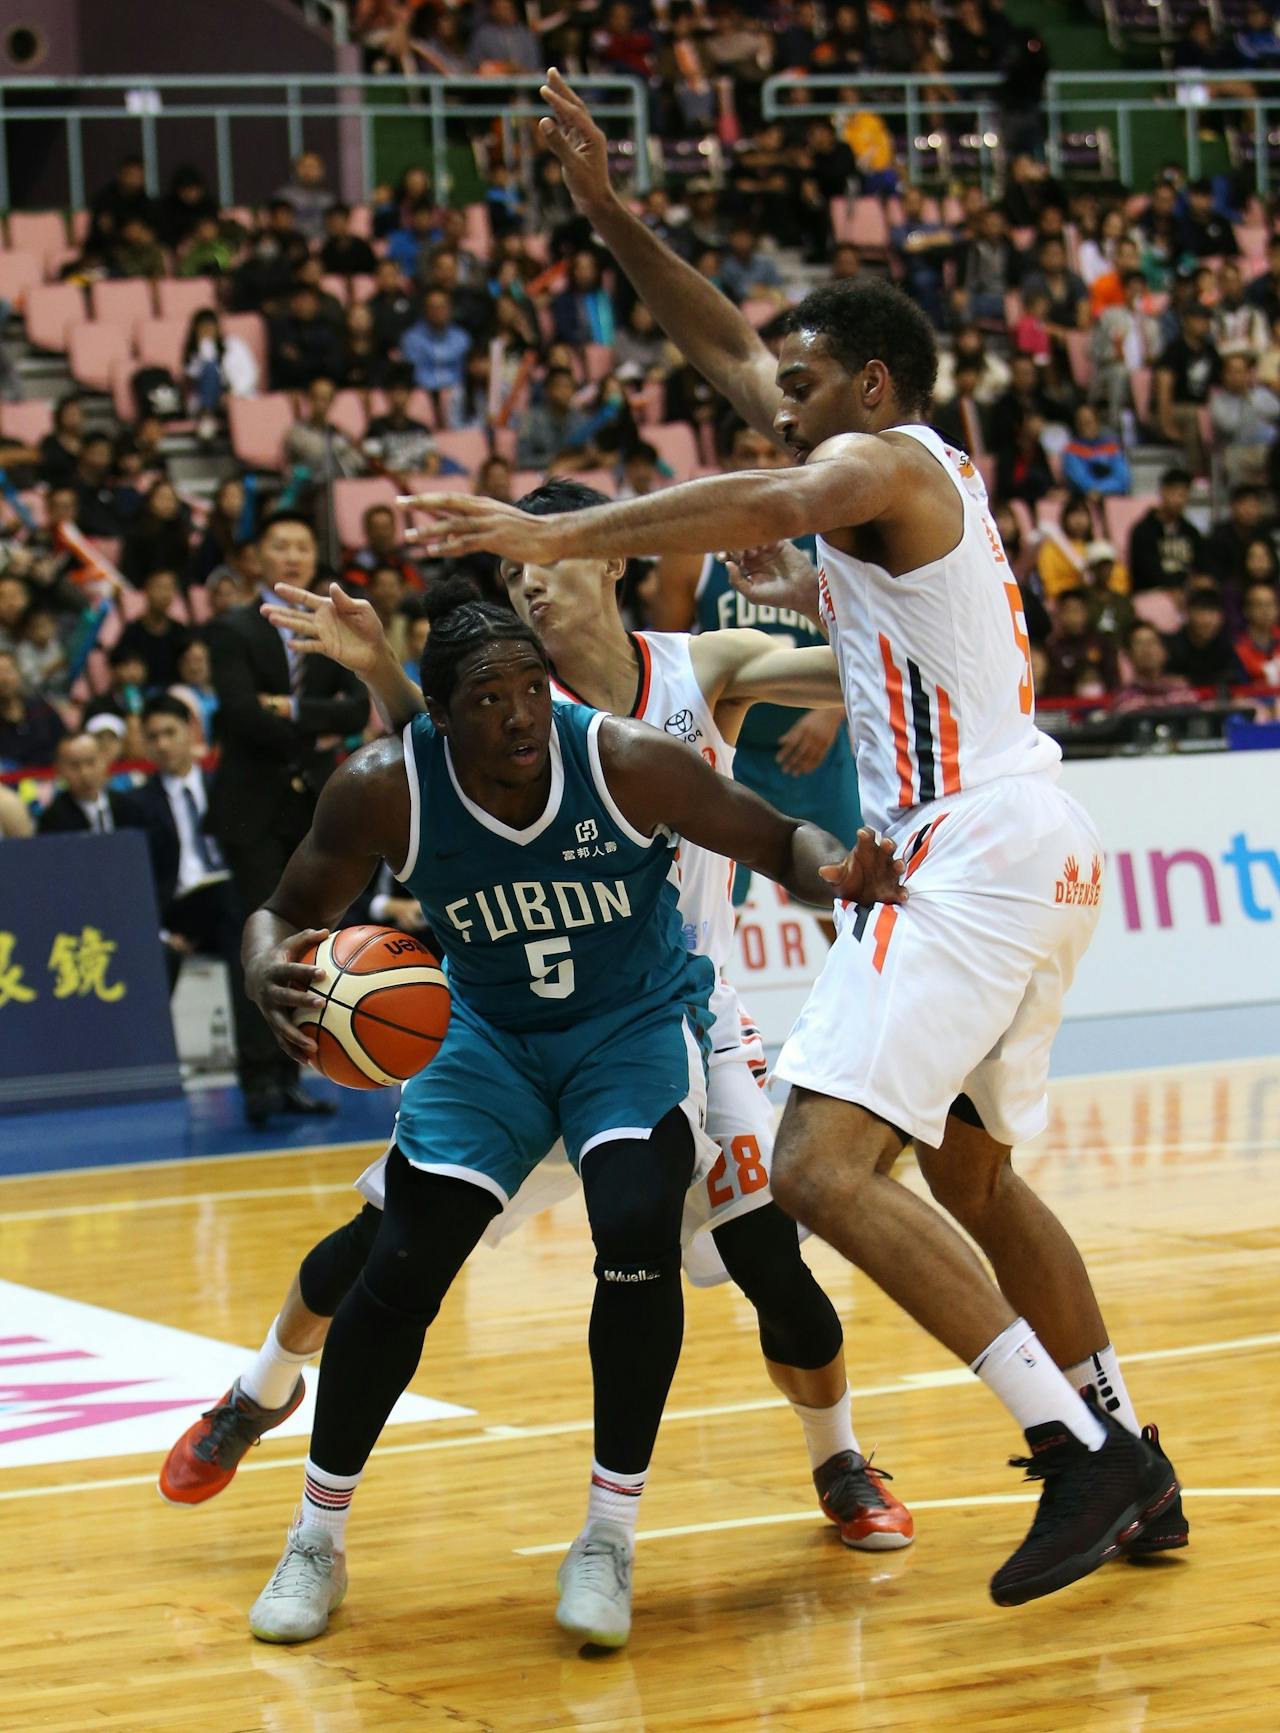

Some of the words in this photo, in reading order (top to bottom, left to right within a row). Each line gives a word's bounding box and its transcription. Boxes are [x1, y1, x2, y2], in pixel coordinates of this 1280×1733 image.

[445, 879, 632, 943] FUBON
[1055, 881, 1101, 906] DEFENSE
[524, 936, 575, 999] 5
[706, 1134, 769, 1209] 28
